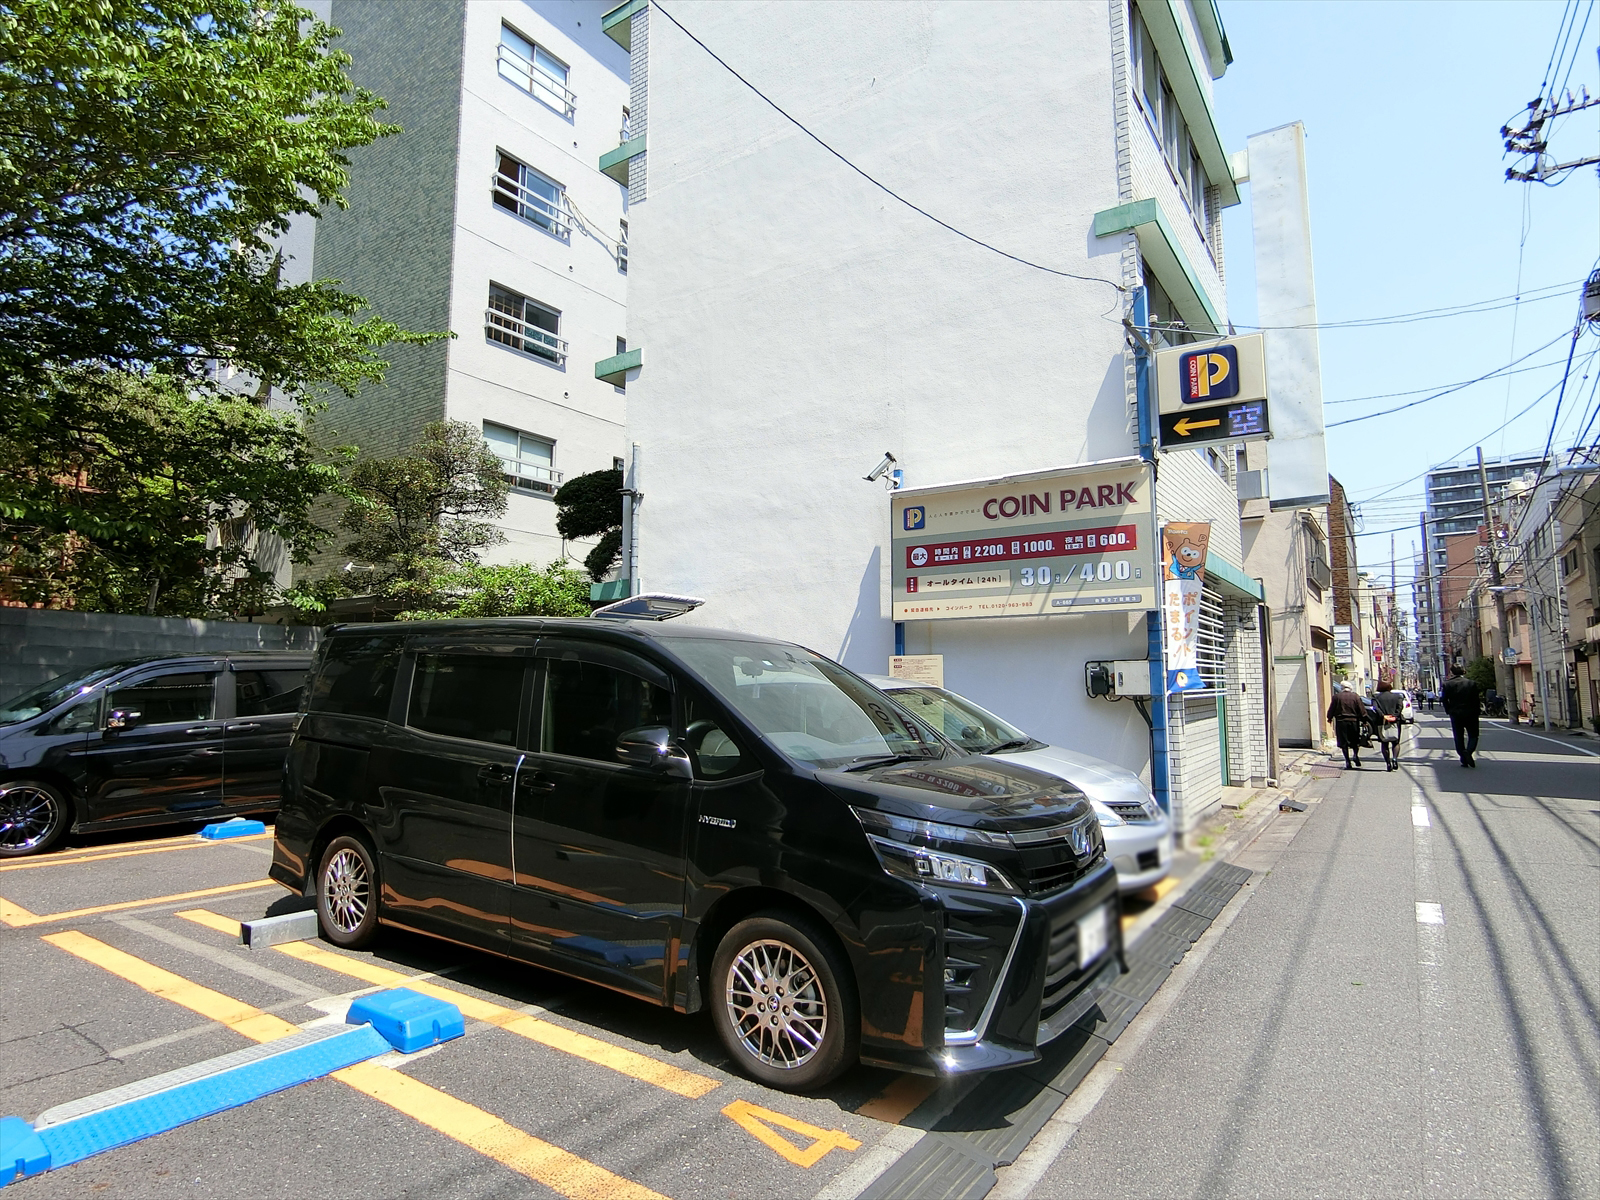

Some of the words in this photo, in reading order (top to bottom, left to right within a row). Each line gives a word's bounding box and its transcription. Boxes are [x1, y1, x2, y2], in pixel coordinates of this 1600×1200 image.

[1190, 359, 1198, 377] COIN
[1191, 377, 1199, 396] PARK
[1197, 353, 1230, 397] P
[1228, 405, 1263, 436] 空
[982, 491, 1050, 520] COIN
[1060, 481, 1138, 511] PARK
[1183, 591, 1198, 657] ポイント
[720, 1098, 863, 1169] 4
